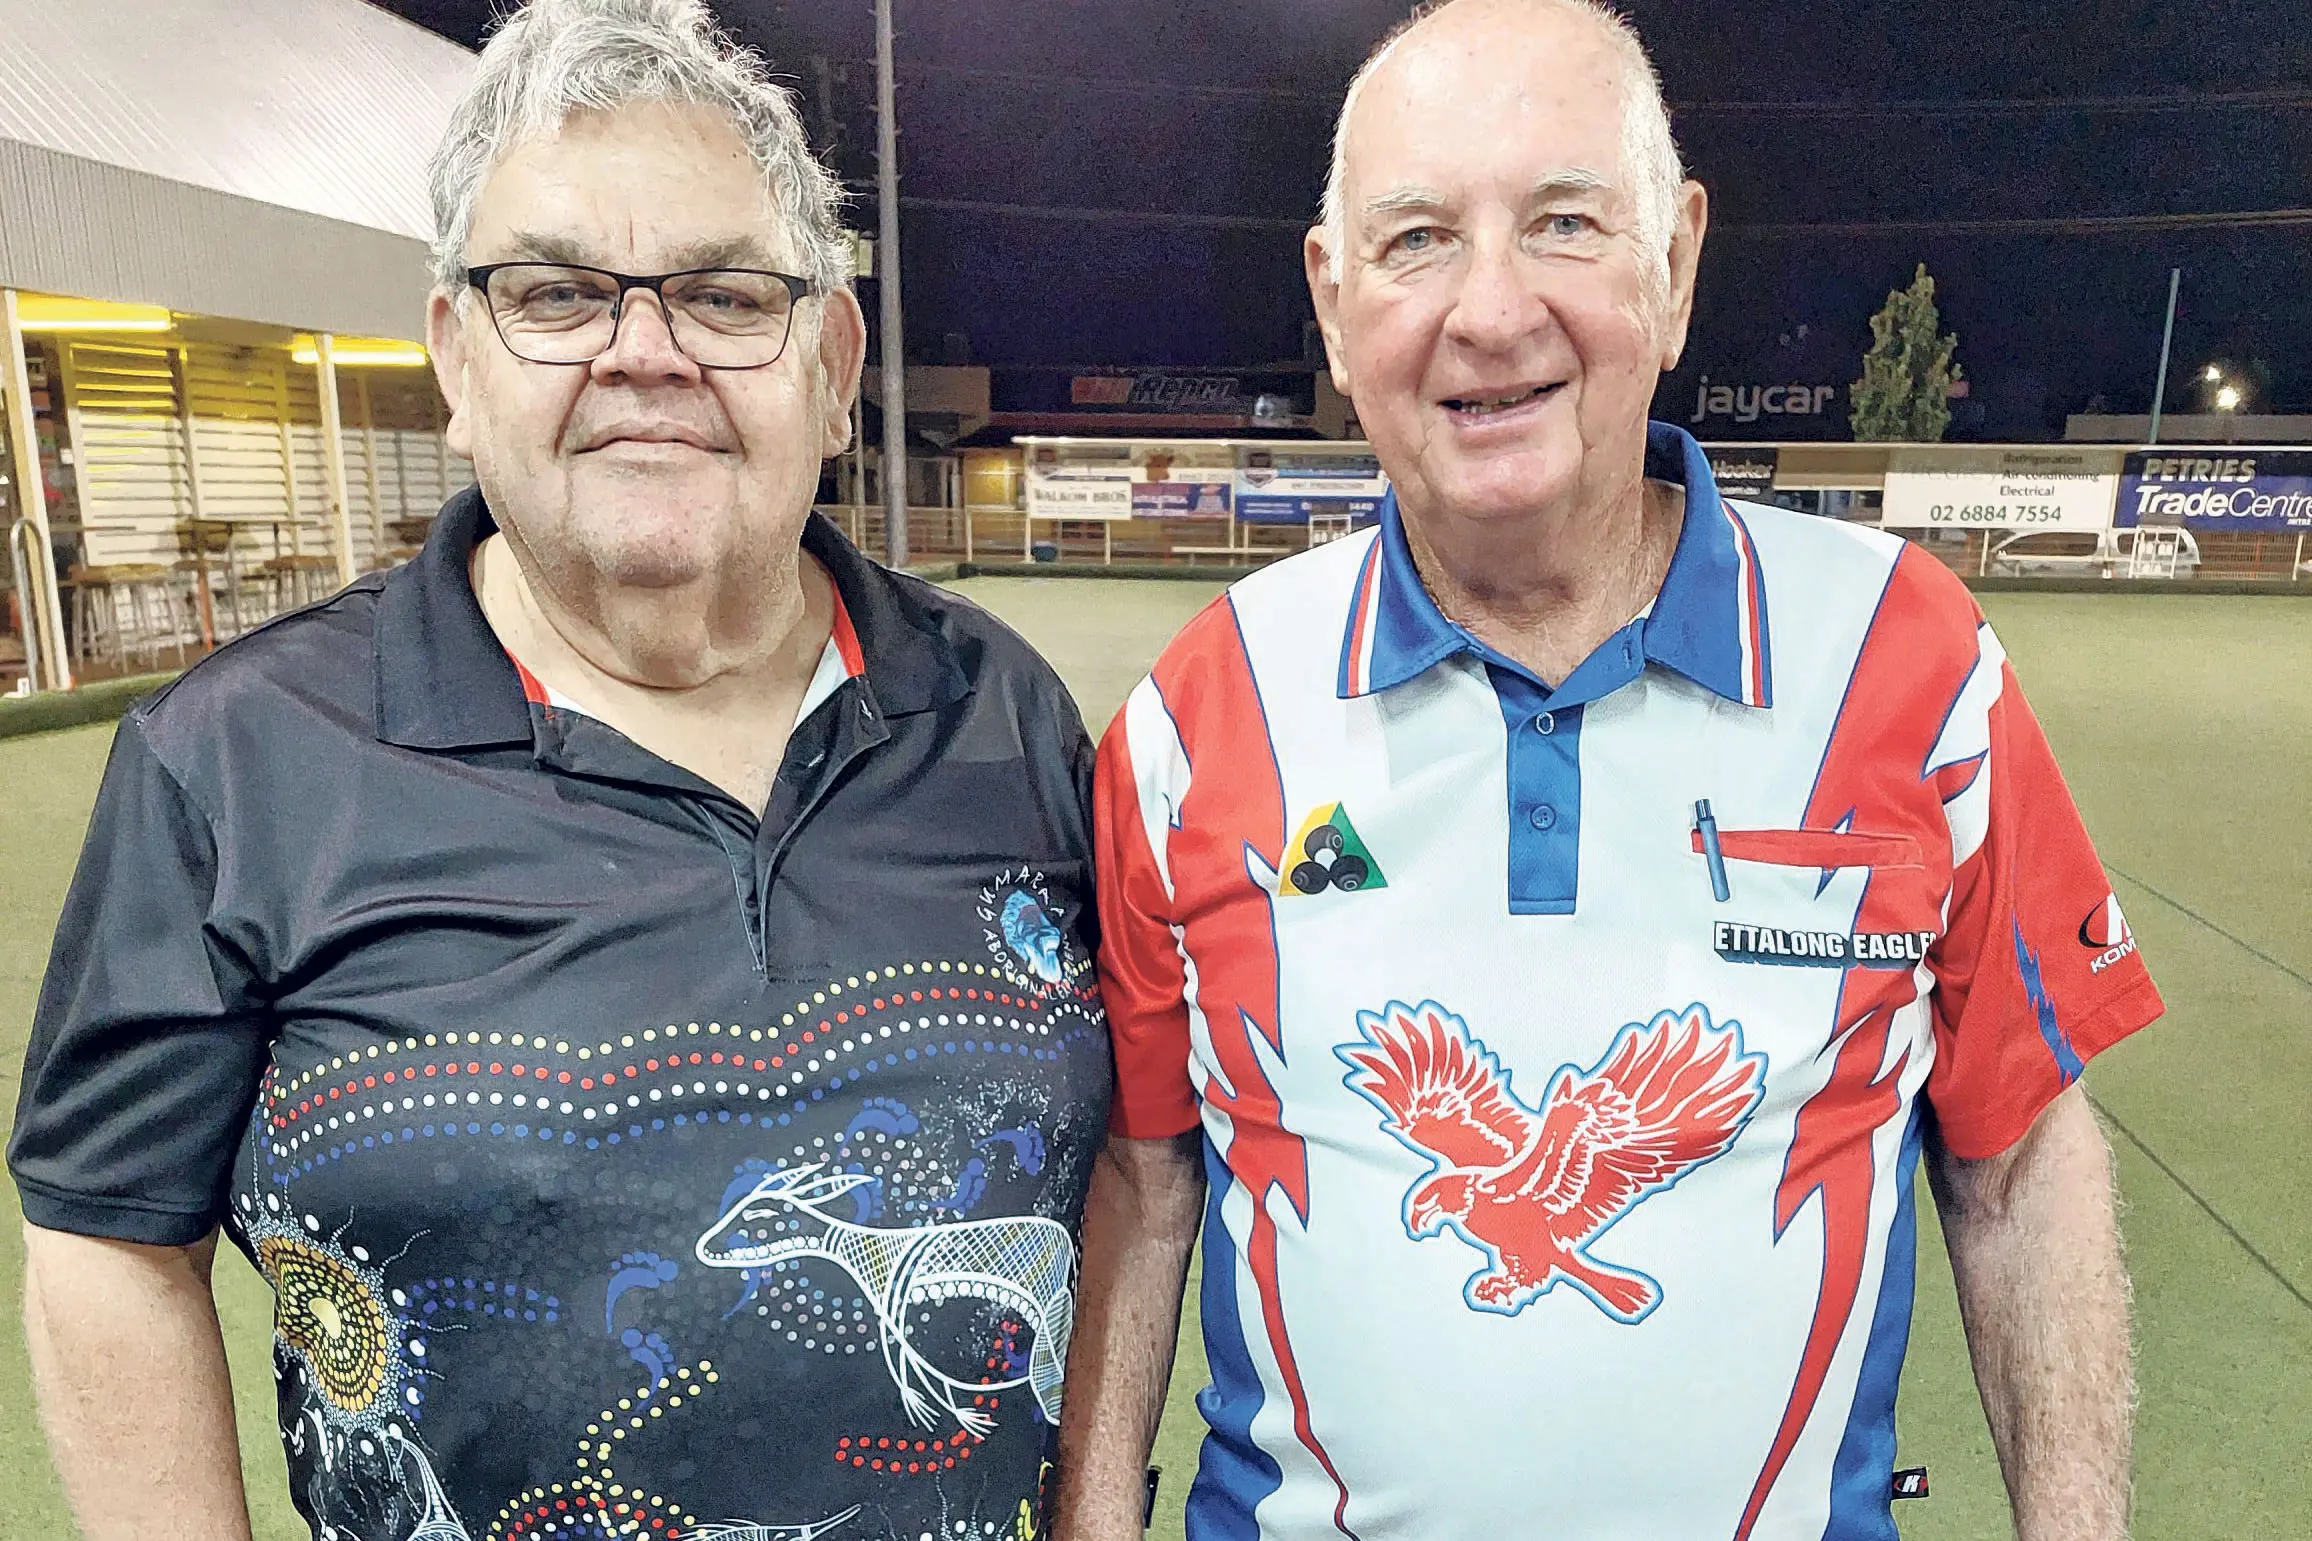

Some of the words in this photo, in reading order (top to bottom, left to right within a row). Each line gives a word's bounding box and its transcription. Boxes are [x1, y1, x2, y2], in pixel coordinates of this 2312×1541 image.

[1690, 375, 1835, 423] jaycar
[2141, 458, 2257, 483] PETRIES
[2000, 485, 2055, 497] Electrical
[1930, 505, 1953, 522] 02
[1960, 505, 2007, 522] 6884
[2015, 505, 2062, 523] 7554
[1714, 921, 1847, 960] ETTALONG
